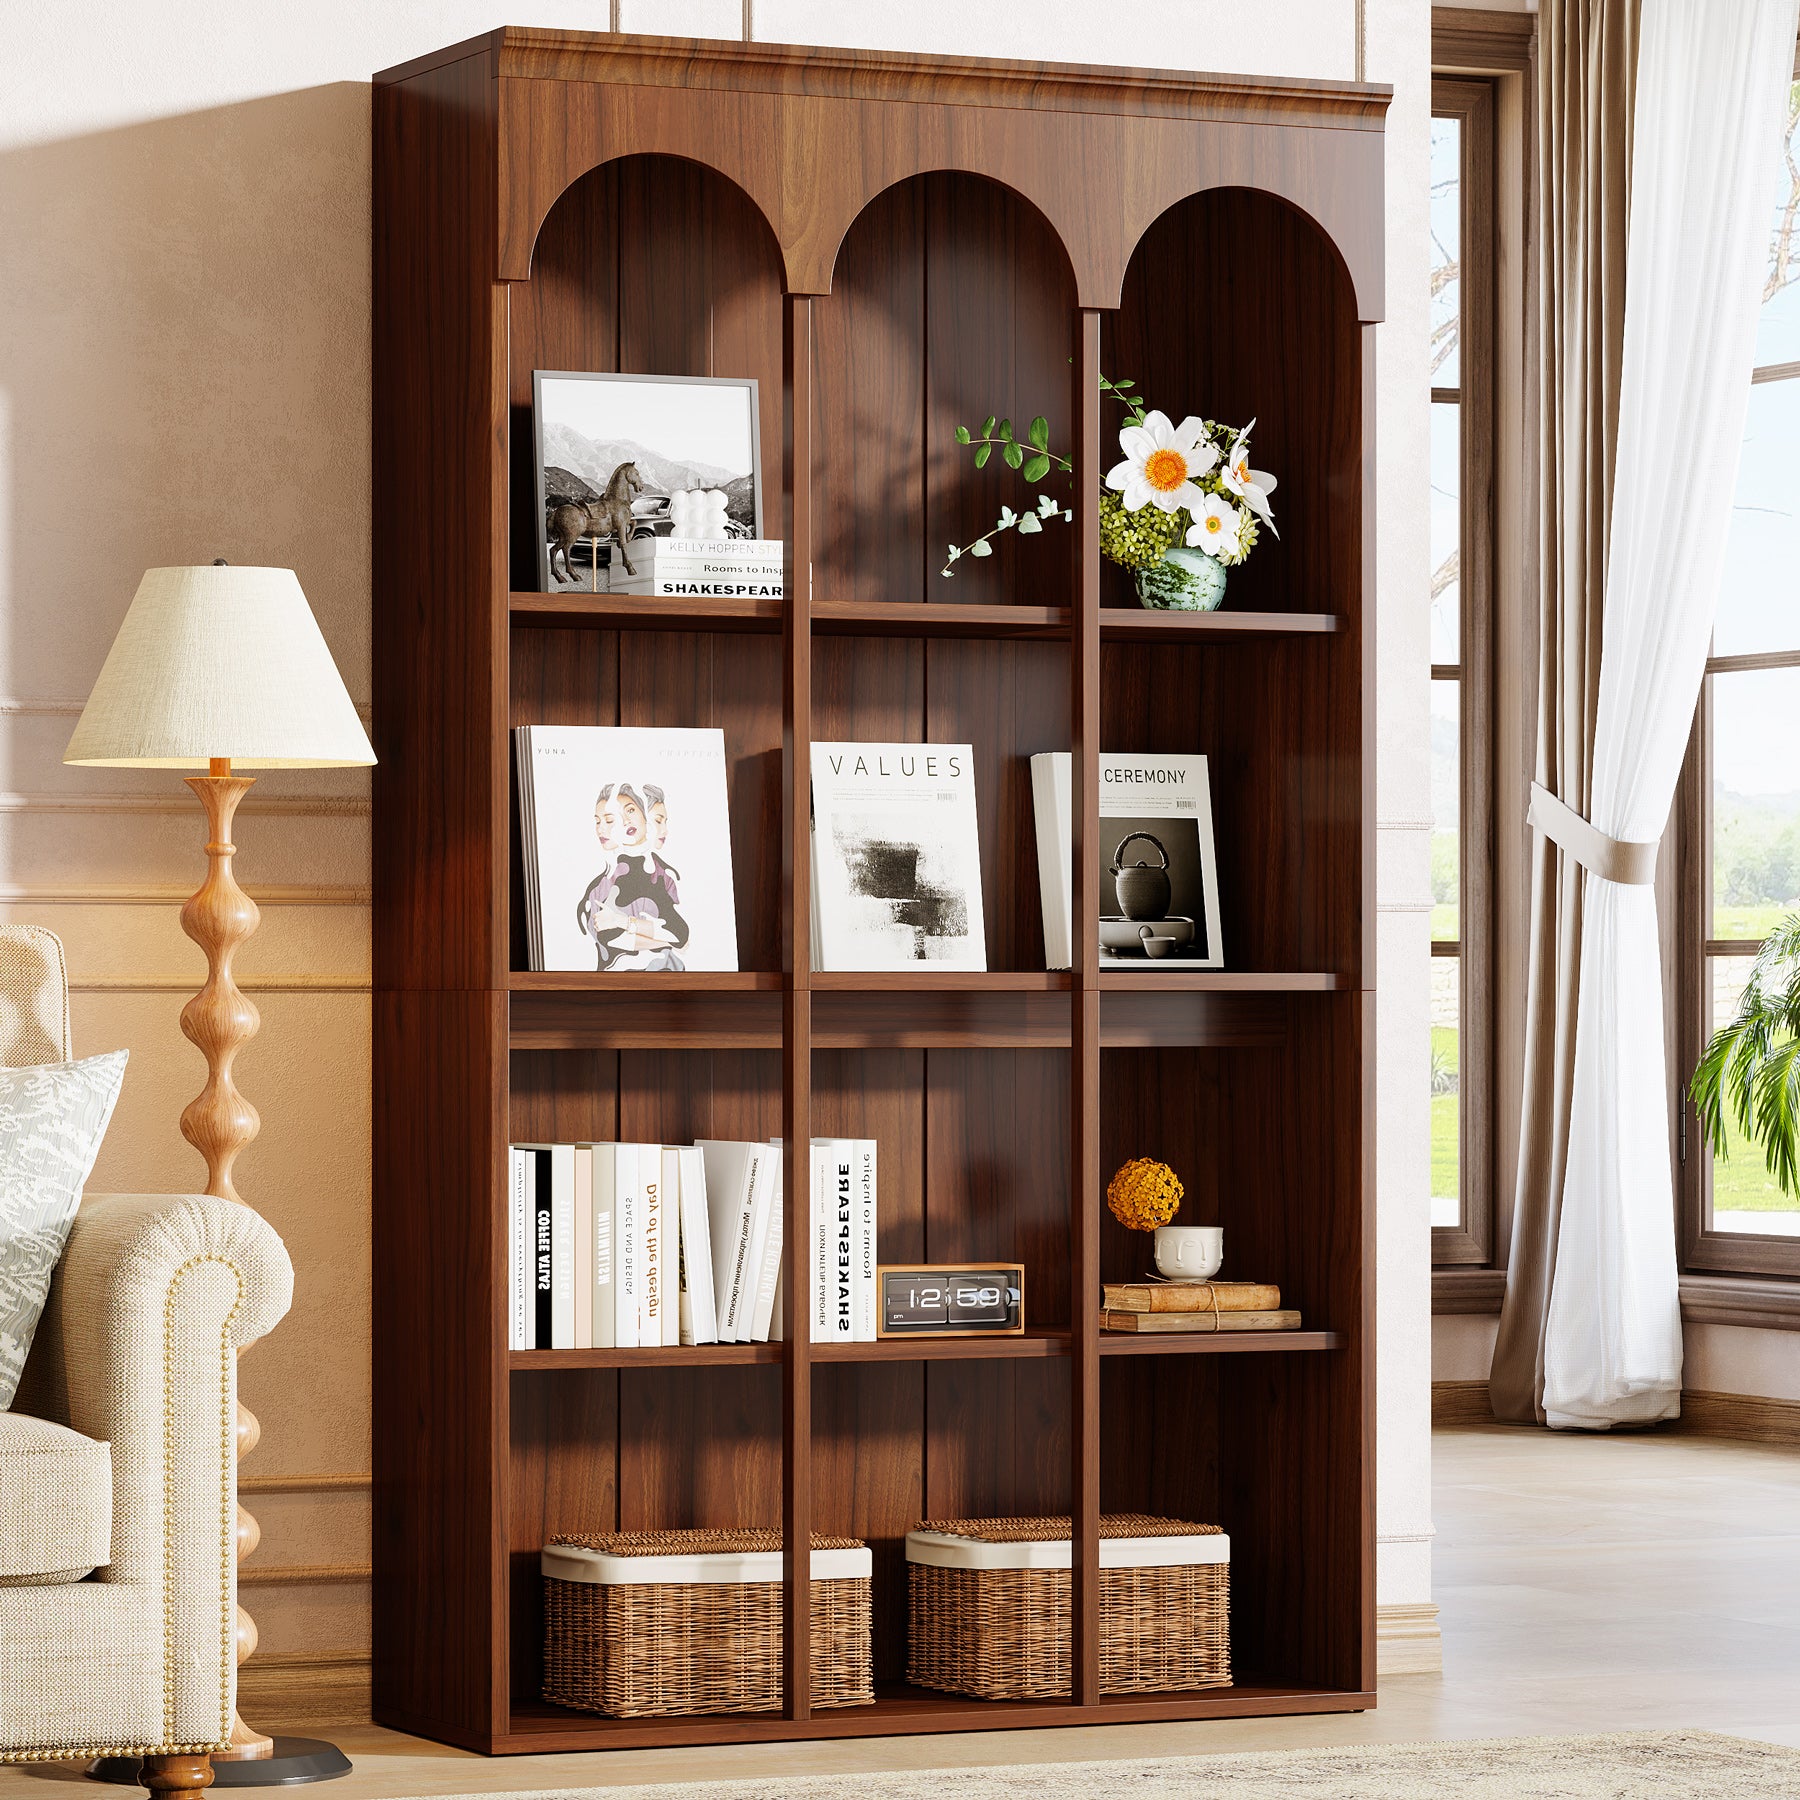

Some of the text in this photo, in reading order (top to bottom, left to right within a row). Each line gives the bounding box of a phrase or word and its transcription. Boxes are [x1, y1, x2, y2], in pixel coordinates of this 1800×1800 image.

[669, 542, 705, 554] KELLY
[708, 543, 754, 554] HOPPEN
[704, 564, 743, 573] Rooms
[746, 565, 759, 574] to
[663, 583, 783, 596] SHAKESPEAR
[537, 747, 566, 755] YUNA
[829, 755, 961, 777] VALUES
[1104, 768, 1186, 784] CEREMONY
[910, 1287, 1000, 1308] 12 59
